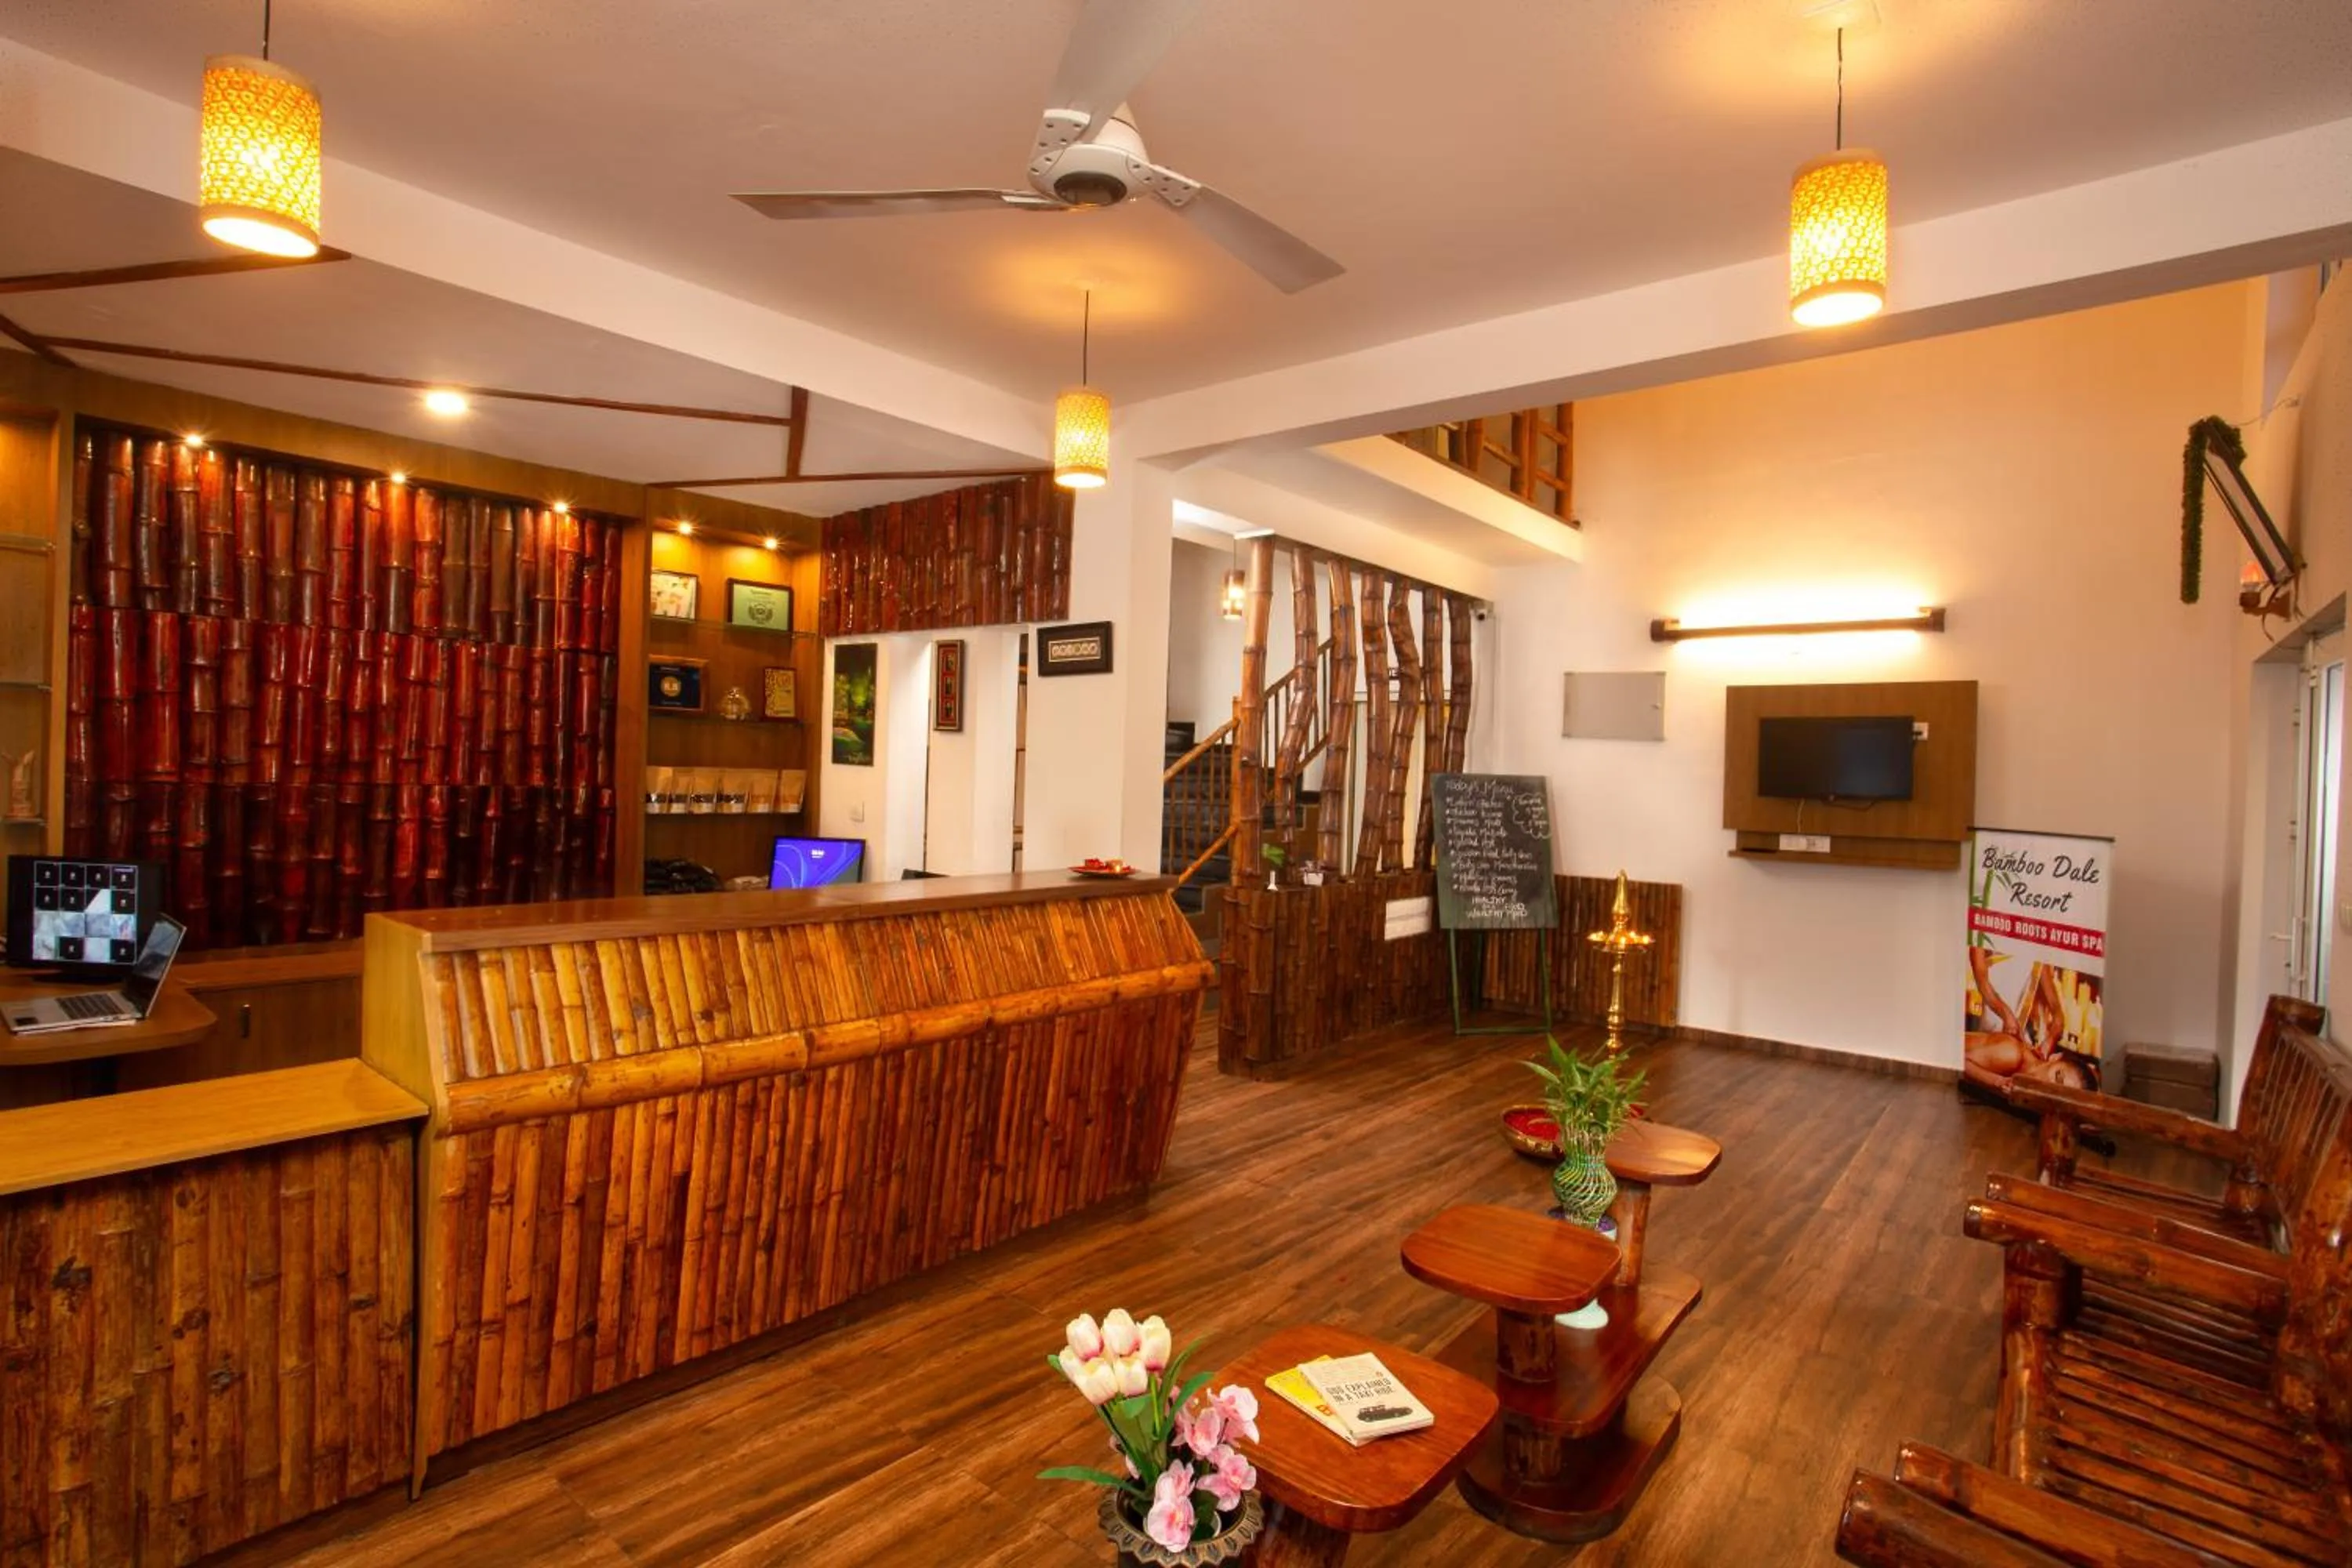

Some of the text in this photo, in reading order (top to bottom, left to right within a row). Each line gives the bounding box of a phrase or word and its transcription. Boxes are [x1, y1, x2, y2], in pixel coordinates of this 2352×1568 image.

[1982, 848, 2100, 884] Bamboo Dale
[2009, 881, 2073, 913] Resort
[1974, 913, 2103, 952] BAMBOO ROOTS AYUR SPA
[1344, 1377, 1392, 1393] EXPLAINED
[1353, 1389, 1374, 1399] TAXI
